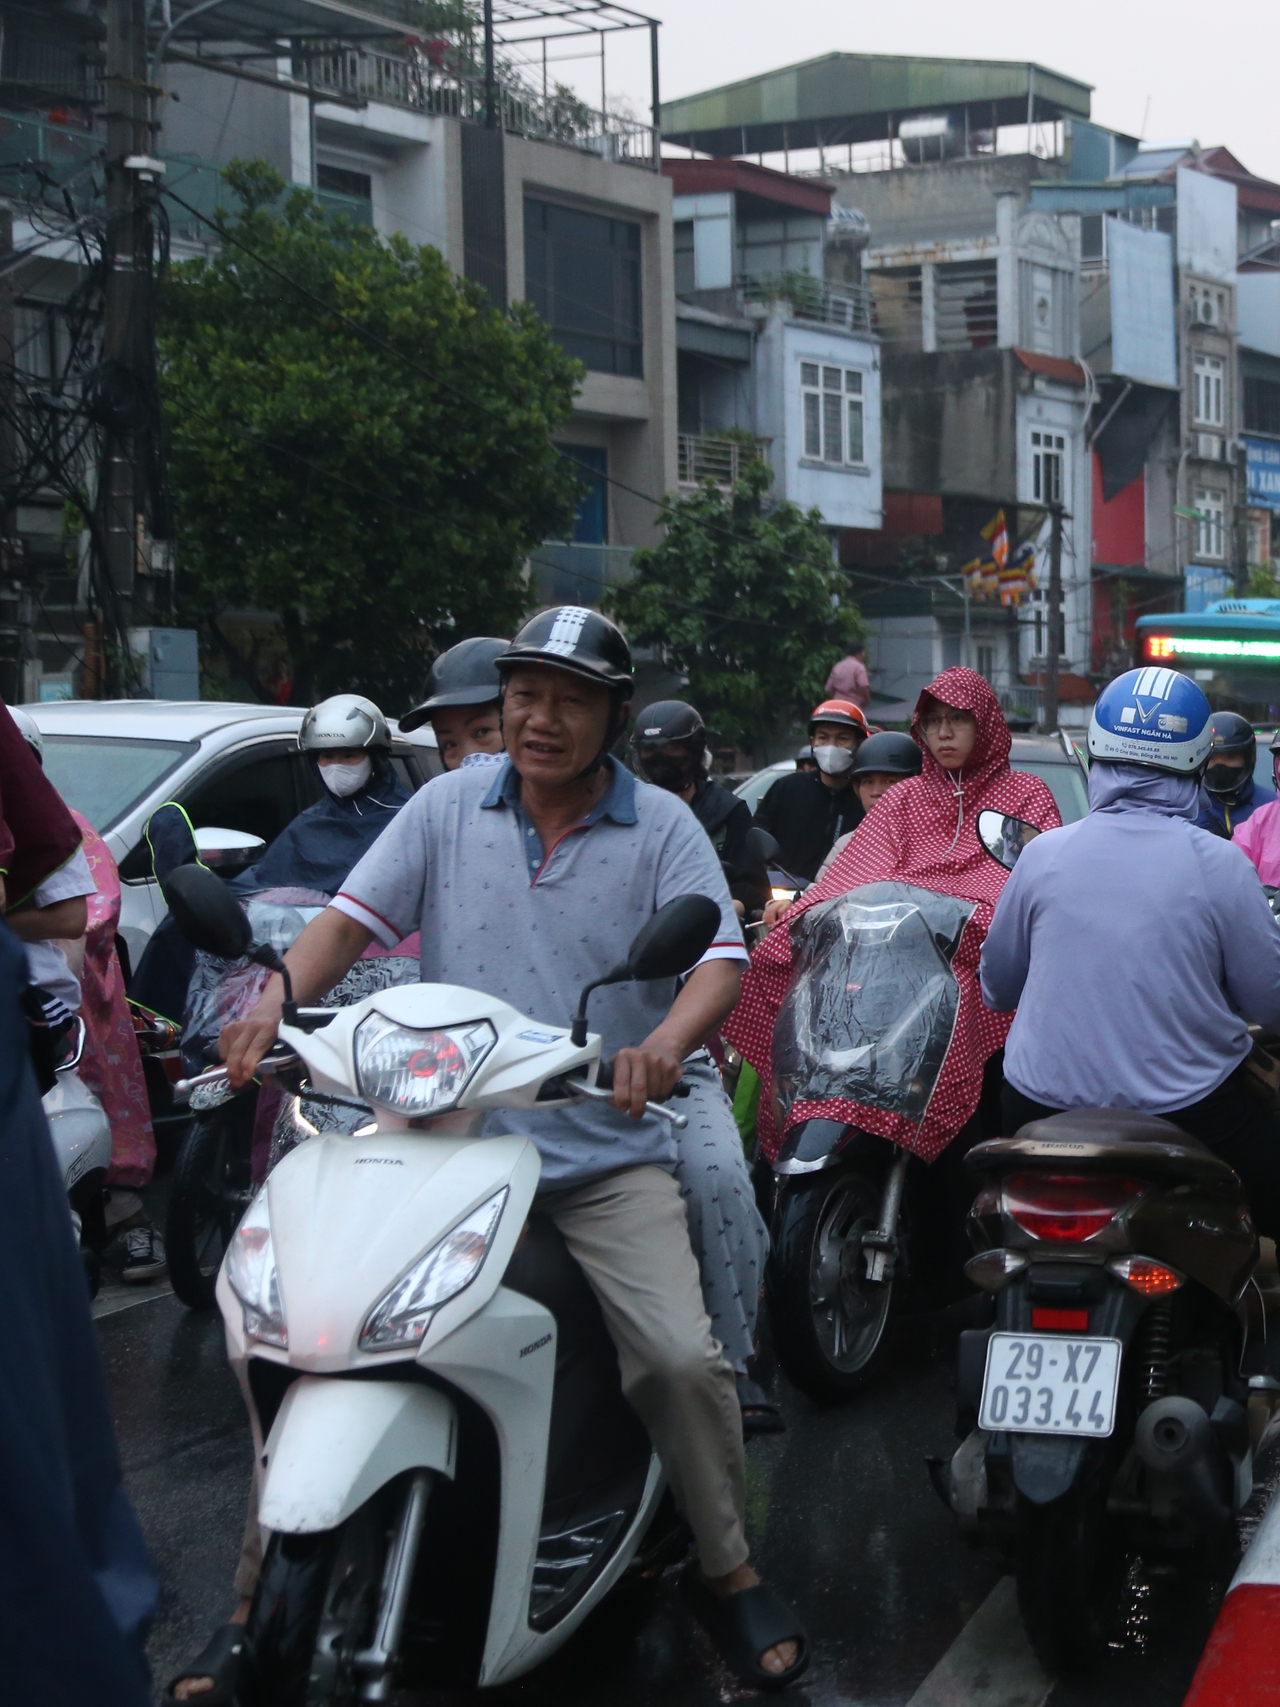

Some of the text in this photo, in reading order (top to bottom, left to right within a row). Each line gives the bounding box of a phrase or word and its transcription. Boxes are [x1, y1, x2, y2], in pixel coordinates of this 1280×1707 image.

[1113, 725, 1140, 734] VINFAST
[519, 1333, 552, 1359] HONDA
[1005, 1342, 1101, 1384] 29-X7
[989, 1385, 1105, 1429] 033.44
